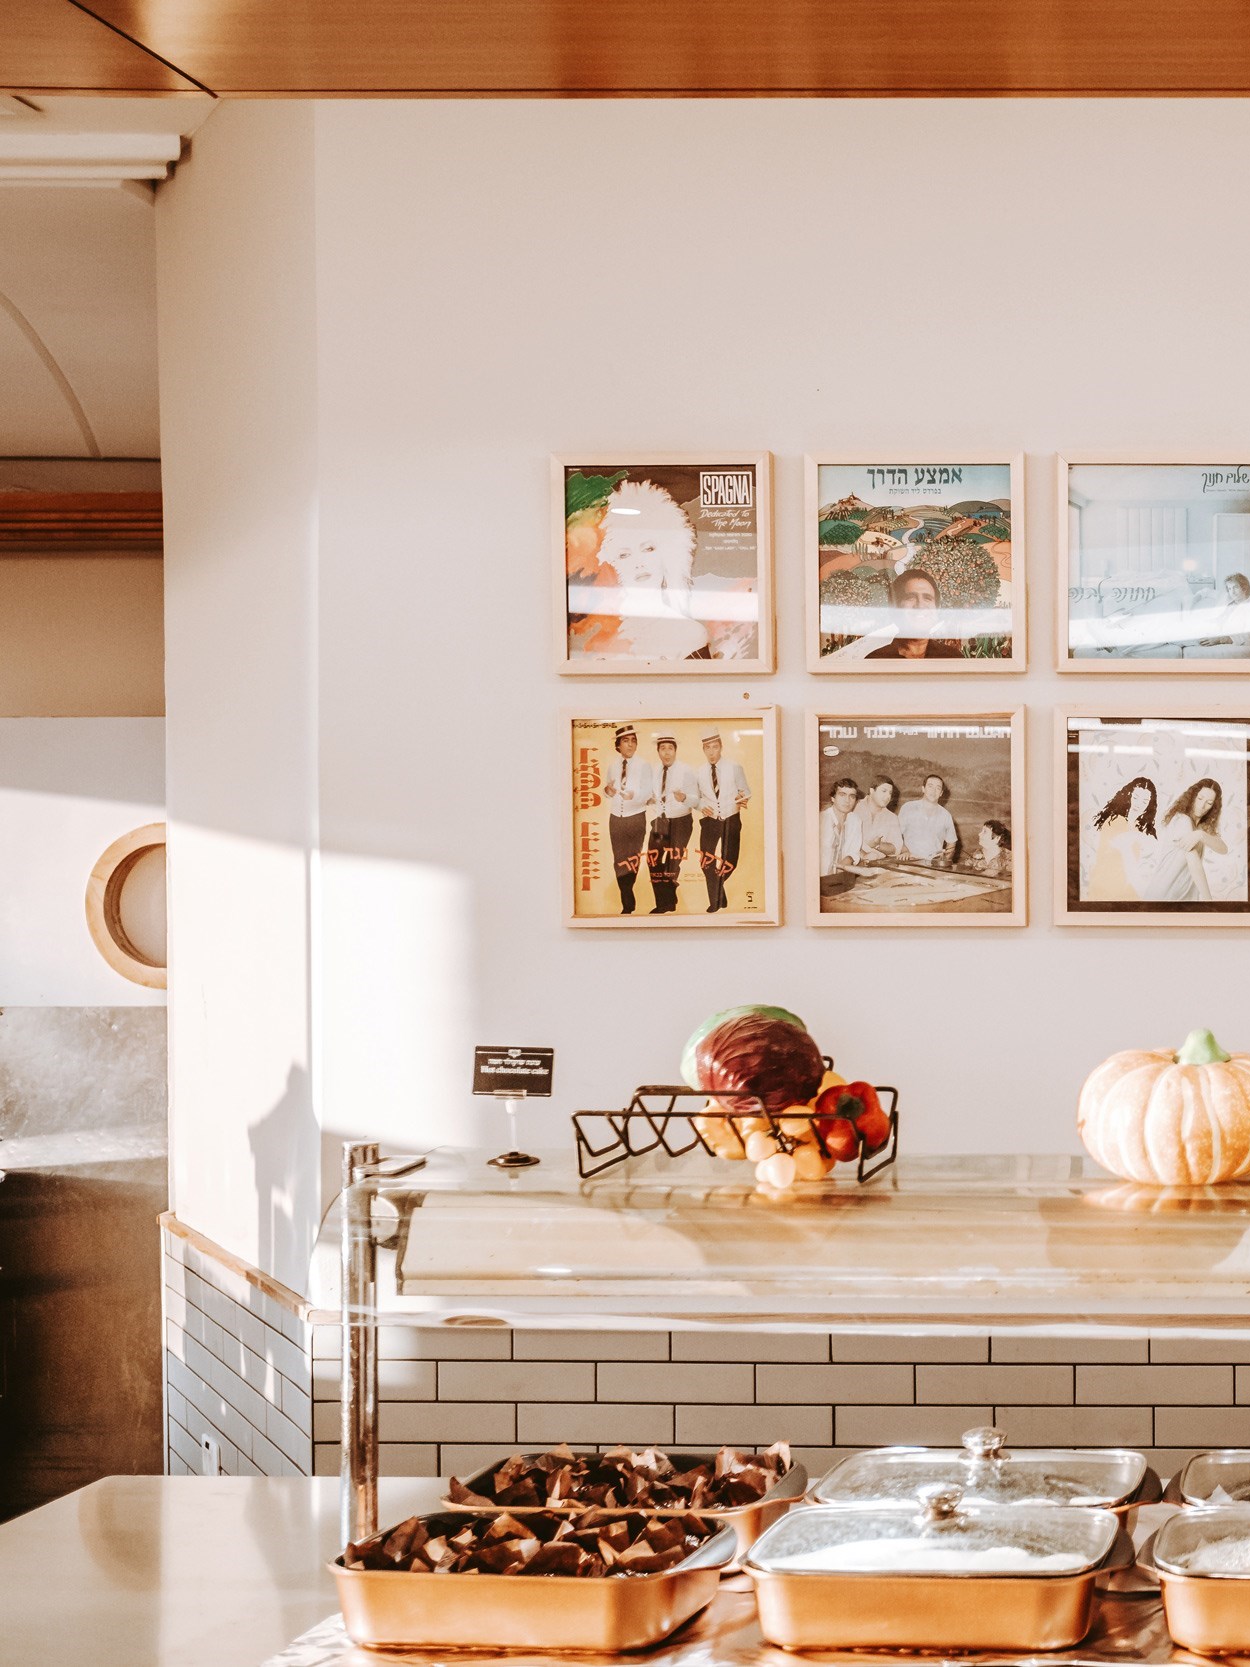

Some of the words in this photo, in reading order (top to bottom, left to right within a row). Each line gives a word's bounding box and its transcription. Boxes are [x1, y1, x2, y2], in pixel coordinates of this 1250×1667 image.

[866, 468, 908, 490] הדרך
[914, 467, 963, 486] אמצע
[1201, 472, 1224, 494] חנוך
[1226, 464, 1250, 484] שלום
[703, 475, 750, 505] SPAGNA
[698, 508, 740, 519] Dedicated
[711, 518, 728, 530] The
[729, 518, 752, 530] Moon
[1112, 587, 1156, 603] חתונה
[694, 848, 736, 878] קרקר
[496, 1066, 531, 1074] chocolate
